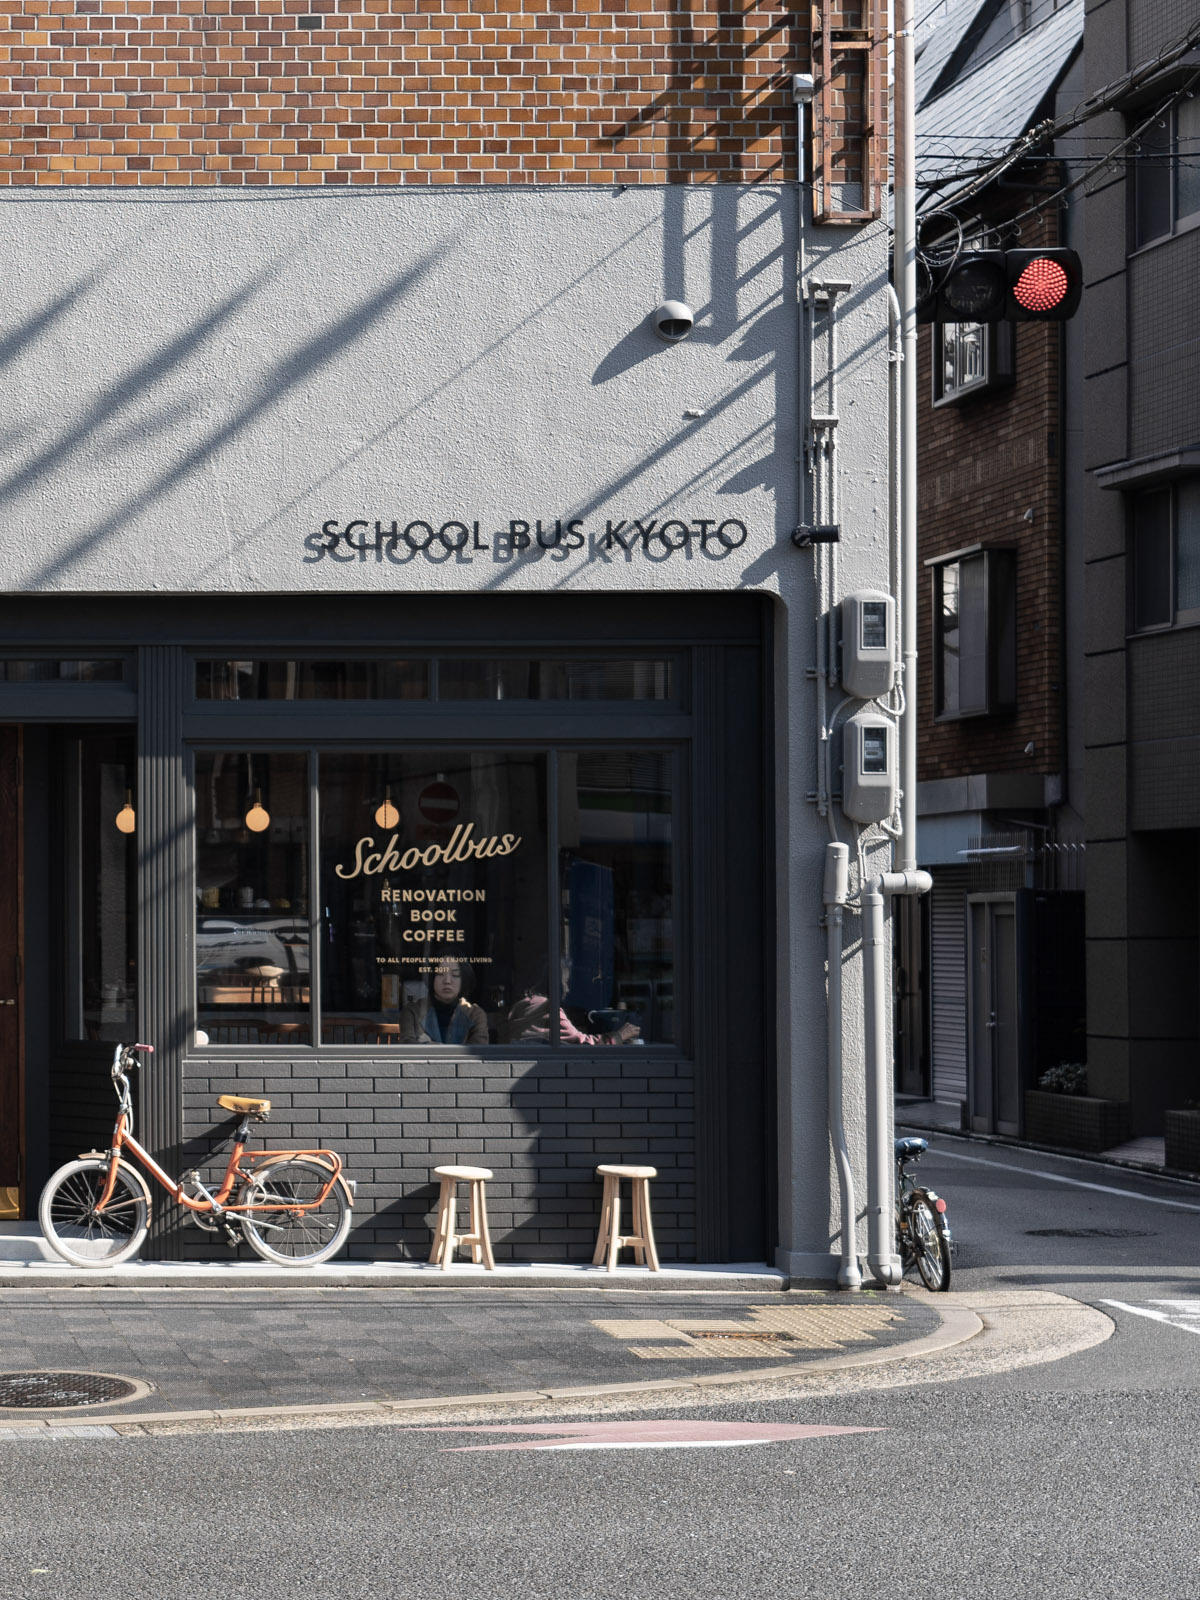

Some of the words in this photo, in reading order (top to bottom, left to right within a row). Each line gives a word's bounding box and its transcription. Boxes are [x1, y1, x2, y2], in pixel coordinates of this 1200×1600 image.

[321, 518, 491, 552] SCHOOL
[510, 518, 585, 551] BUS
[606, 517, 749, 551] KYOTO
[335, 822, 522, 880] Schoolbus
[381, 889, 486, 902] RENOVATION
[410, 909, 457, 923] BOOK
[402, 929, 465, 942] COFFEE
